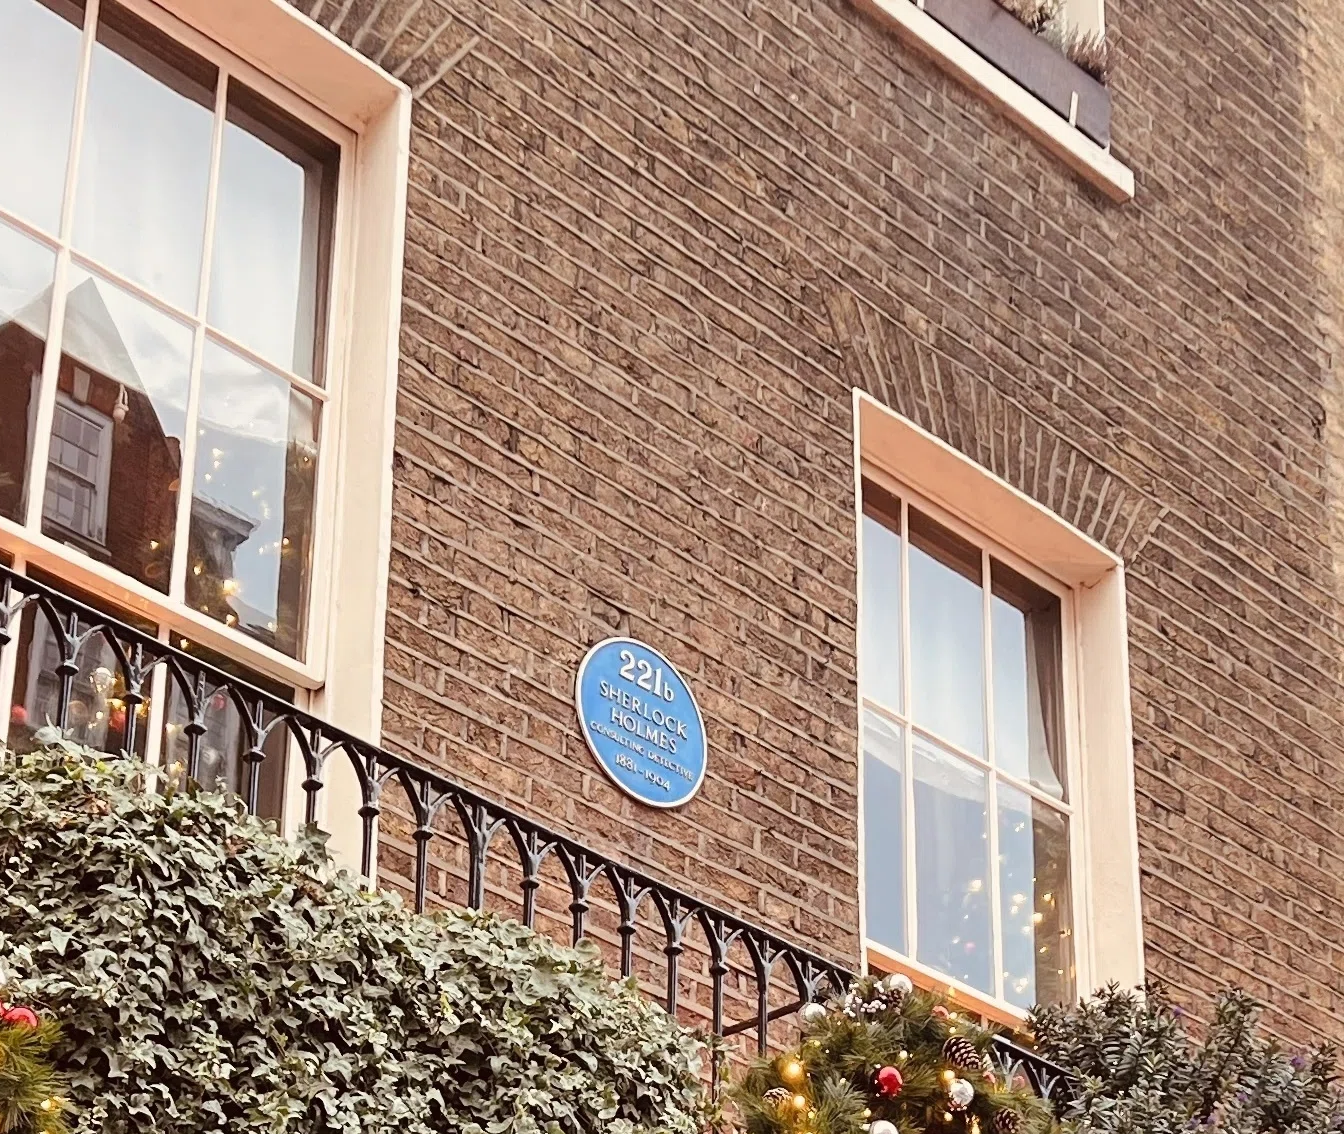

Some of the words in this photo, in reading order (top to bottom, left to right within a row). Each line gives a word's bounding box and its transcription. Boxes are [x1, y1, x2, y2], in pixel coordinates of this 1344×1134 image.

[619, 650, 675, 702] 221b
[599, 680, 688, 741] SHERLOCK
[610, 707, 677, 755] HOLMES
[589, 720, 645, 758] CONSULTING
[647, 750, 694, 782] DETECTIVE
